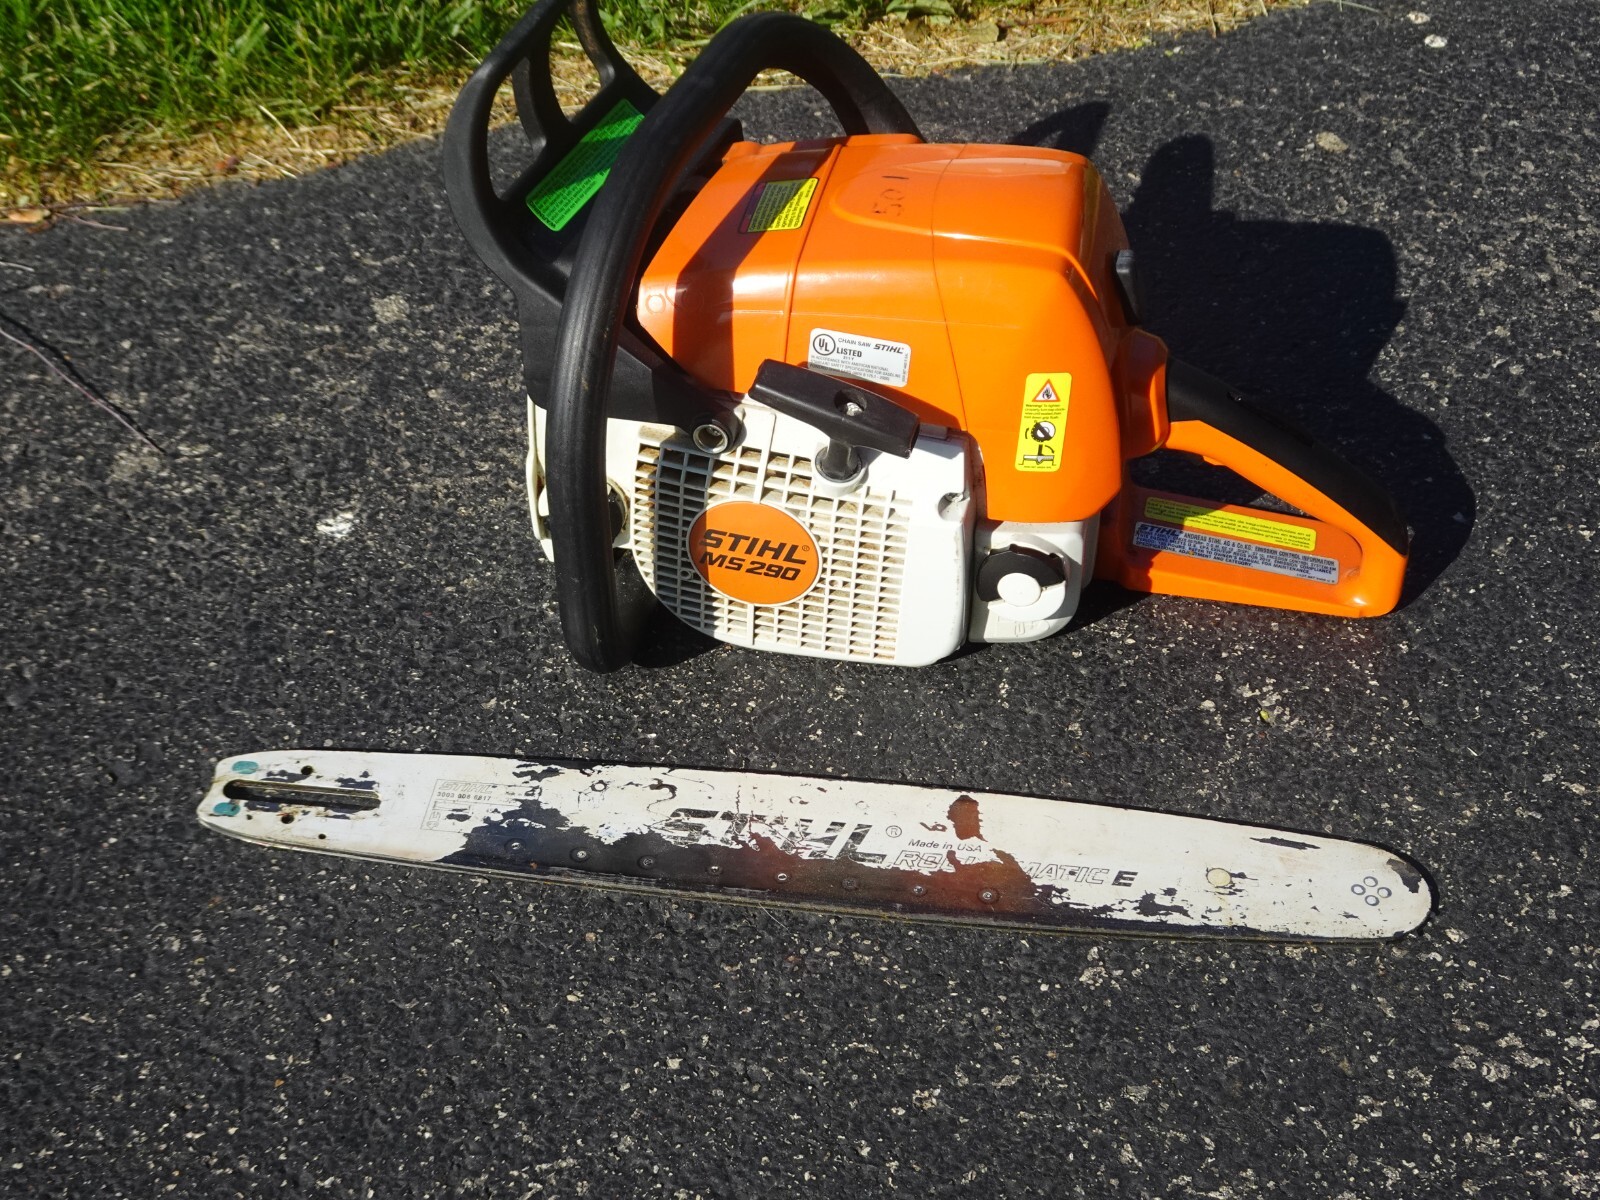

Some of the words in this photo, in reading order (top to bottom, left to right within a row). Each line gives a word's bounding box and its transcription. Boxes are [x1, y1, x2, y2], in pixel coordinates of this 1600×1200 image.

[836, 347, 862, 358] LISTED
[874, 343, 904, 354] STIHL
[699, 529, 806, 564] STIHL
[1138, 523, 1180, 537] STIHL
[1184, 532, 1207, 542] ANDREAS
[1255, 546, 1278, 555] EMISSION
[1279, 551, 1301, 560] CONTROL
[1302, 555, 1335, 566] INFORMATION
[699, 552, 745, 571] MS
[746, 561, 801, 581] 290
[908, 838, 940, 849] Made
[942, 842, 952, 850] in
[957, 842, 982, 852] USA
[1112, 870, 1138, 888] E
